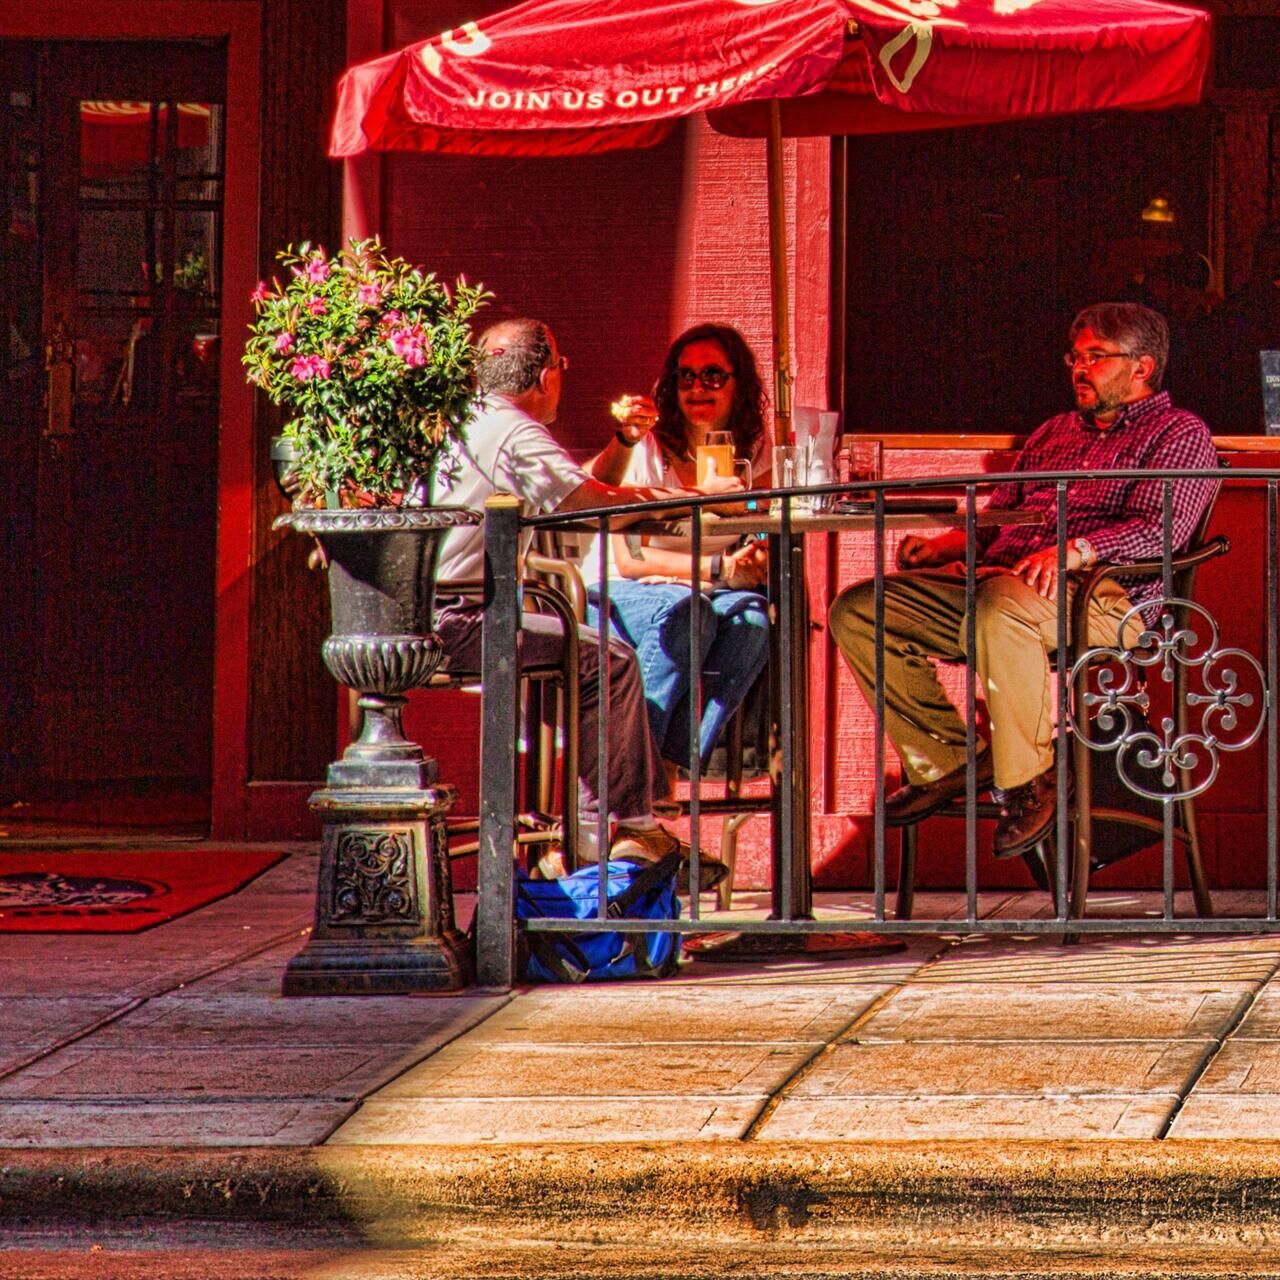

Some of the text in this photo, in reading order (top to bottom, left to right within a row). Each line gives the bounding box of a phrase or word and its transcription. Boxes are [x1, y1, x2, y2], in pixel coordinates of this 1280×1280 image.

[467, 89, 549, 111] JOIN
[564, 91, 604, 110] US
[616, 86, 685, 109] OUT
